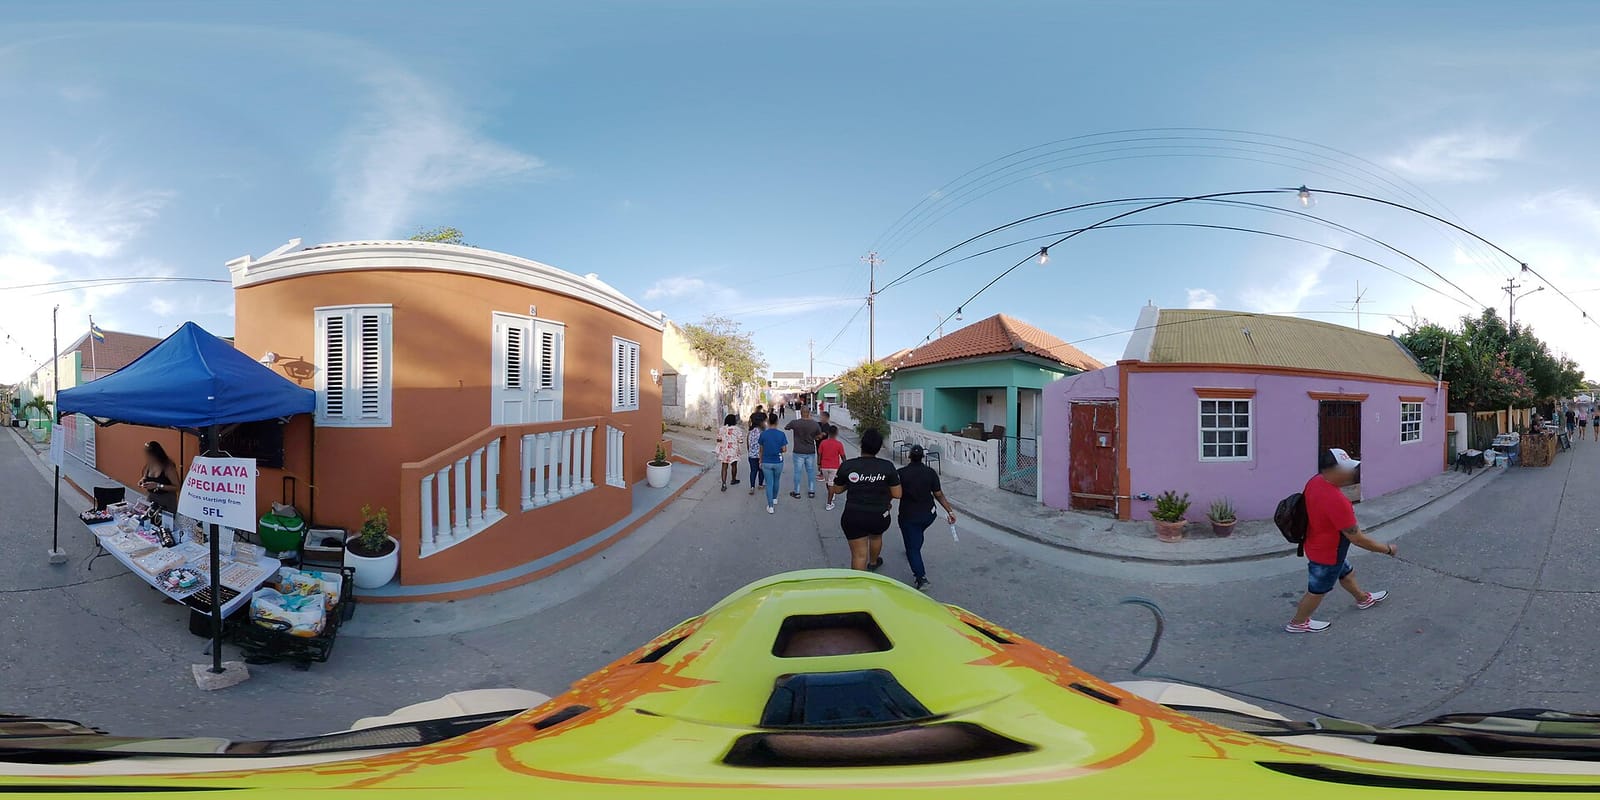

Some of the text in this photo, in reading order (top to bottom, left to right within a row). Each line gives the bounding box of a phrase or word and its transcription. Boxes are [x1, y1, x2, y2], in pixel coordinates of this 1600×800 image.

[211, 465, 248, 478] KAYA
[859, 473, 886, 483] bright
[187, 476, 246, 495] SPECIAL!!!
[202, 496, 227, 505] starting
